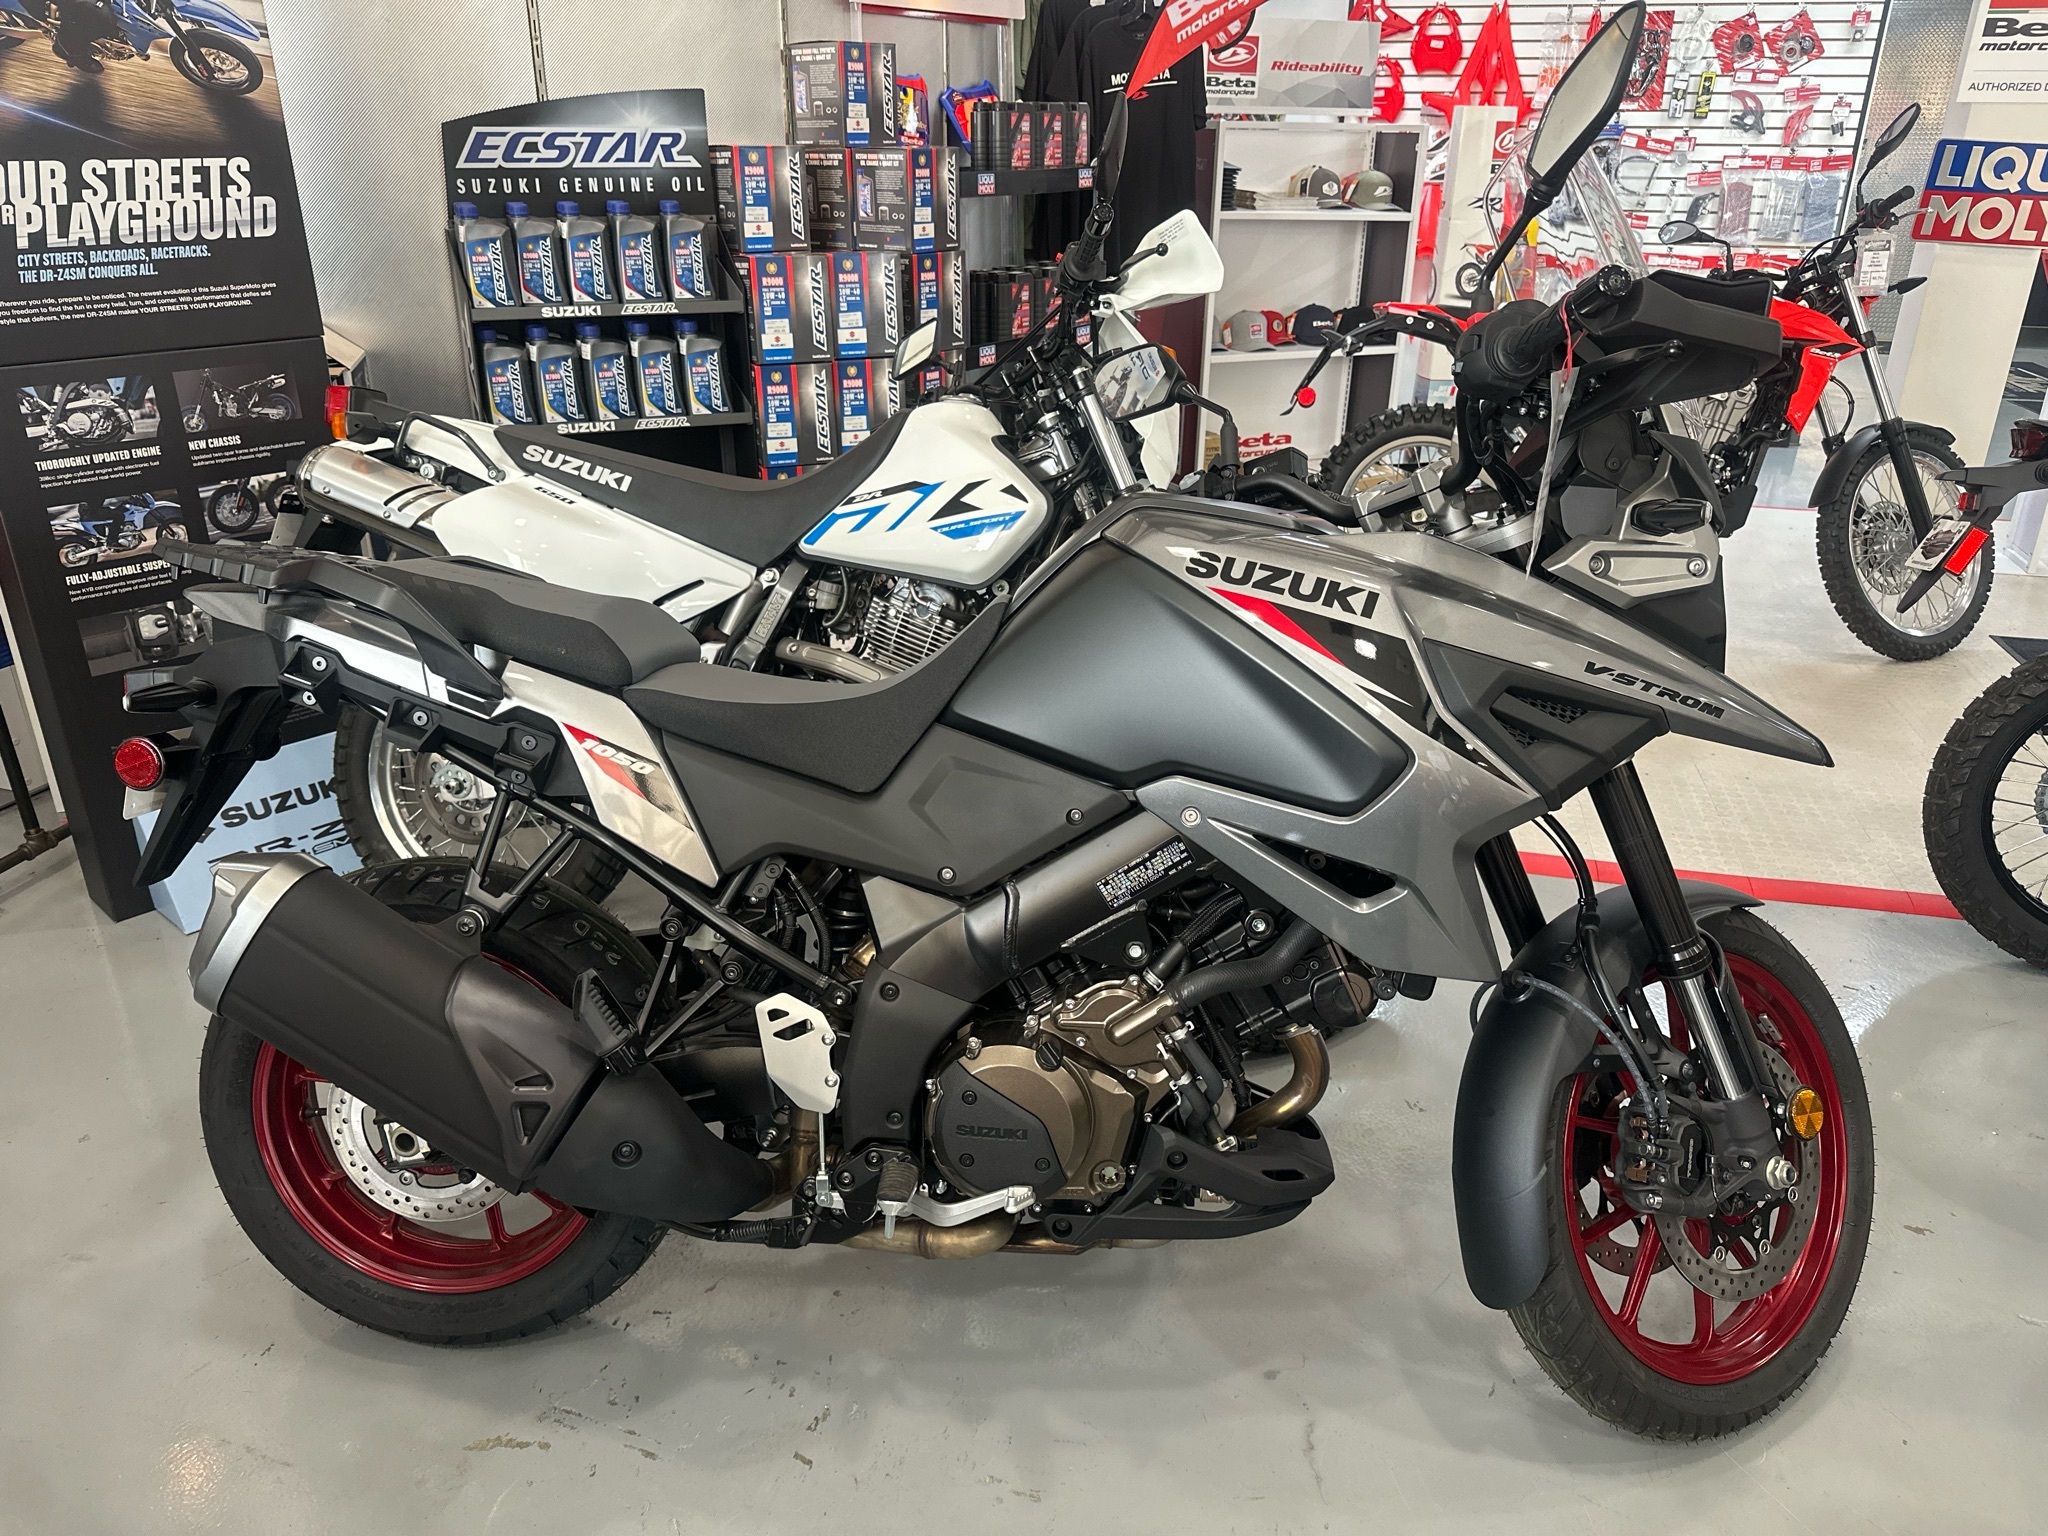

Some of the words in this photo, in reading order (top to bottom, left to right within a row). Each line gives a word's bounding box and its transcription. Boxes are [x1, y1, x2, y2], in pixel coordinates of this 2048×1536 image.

[1206, 76, 1256, 88] Beta
[1270, 60, 1364, 76] Rideability
[1968, 82, 2042, 92] AUTHORIZED
[882, 49, 895, 138] ECSTAR
[1206, 88, 1255, 96] motorcycles
[455, 126, 702, 169] ECSTAR
[81, 156, 251, 204] STREETS
[456, 178, 541, 194] SUZUKI
[559, 176, 654, 193] GENUINE
[671, 176, 705, 192] OIL
[744, 166, 764, 175] R9000
[979, 185, 995, 193] MOLY
[787, 151, 805, 241] ECSTAR
[947, 153, 957, 241] ECSTAR
[15, 195, 277, 250] PLAYGROUND
[18, 254, 40, 267] CITY
[43, 252, 88, 266] STREETS,
[90, 248, 149, 263] BACKROADS,
[151, 245, 211, 260] RACETRACKS.
[18, 270, 38, 283] THE
[40, 267, 86, 282] DR-Z4SM
[88, 264, 138, 279] CONQUERS
[139, 263, 158, 276] ALL.
[489, 239, 508, 306] ECSTAR
[539, 237, 556, 302] ECSTAR
[590, 236, 606, 300] ECSTAR
[640, 234, 657, 298] ECSTAR
[690, 233, 706, 297] ECSTAR
[762, 277, 783, 286] R9000
[838, 274, 858, 282] R9000
[920, 272, 935, 281] R9000
[160, 304, 188, 312] STREETS
[209, 300, 252, 308] PLAYGROUND.
[541, 305, 602, 318] SUZUKI
[621, 303, 679, 315] ECSTAR
[809, 260, 828, 352] ECSTAR
[881, 258, 899, 346] ECSTAR
[952, 255, 963, 339] ECSTAR
[508, 360, 527, 423] ECSTAR
[561, 358, 579, 420] ECSTAR
[613, 355, 630, 417] ECSTAR
[660, 353, 677, 414] ECSTAR
[707, 351, 723, 412] ECSTAR
[767, 385, 788, 394] R9000
[842, 379, 862, 387] R9000
[557, 421, 616, 434] SUZUKI
[634, 417, 690, 429] ECSTAR
[813, 368, 832, 455] ECSTAR
[188, 439, 206, 451] NEW
[208, 435, 241, 448] CHASSIS
[1238, 432, 1292, 447] eta
[35, 455, 91, 472] THOROUGHLY
[92, 450, 130, 463] UPDATED
[132, 446, 162, 458] ENGINE
[522, 444, 633, 493] SUZUKI
[852, 490, 883, 503] DR
[66, 565, 141, 586] FULLY-ADJUSTABLE
[1185, 551, 1381, 620] SUZUKI
[1583, 660, 1725, 720] V-STROM
[580, 737, 656, 775] 1050
[956, 1125, 1028, 1140] SUZUKI
